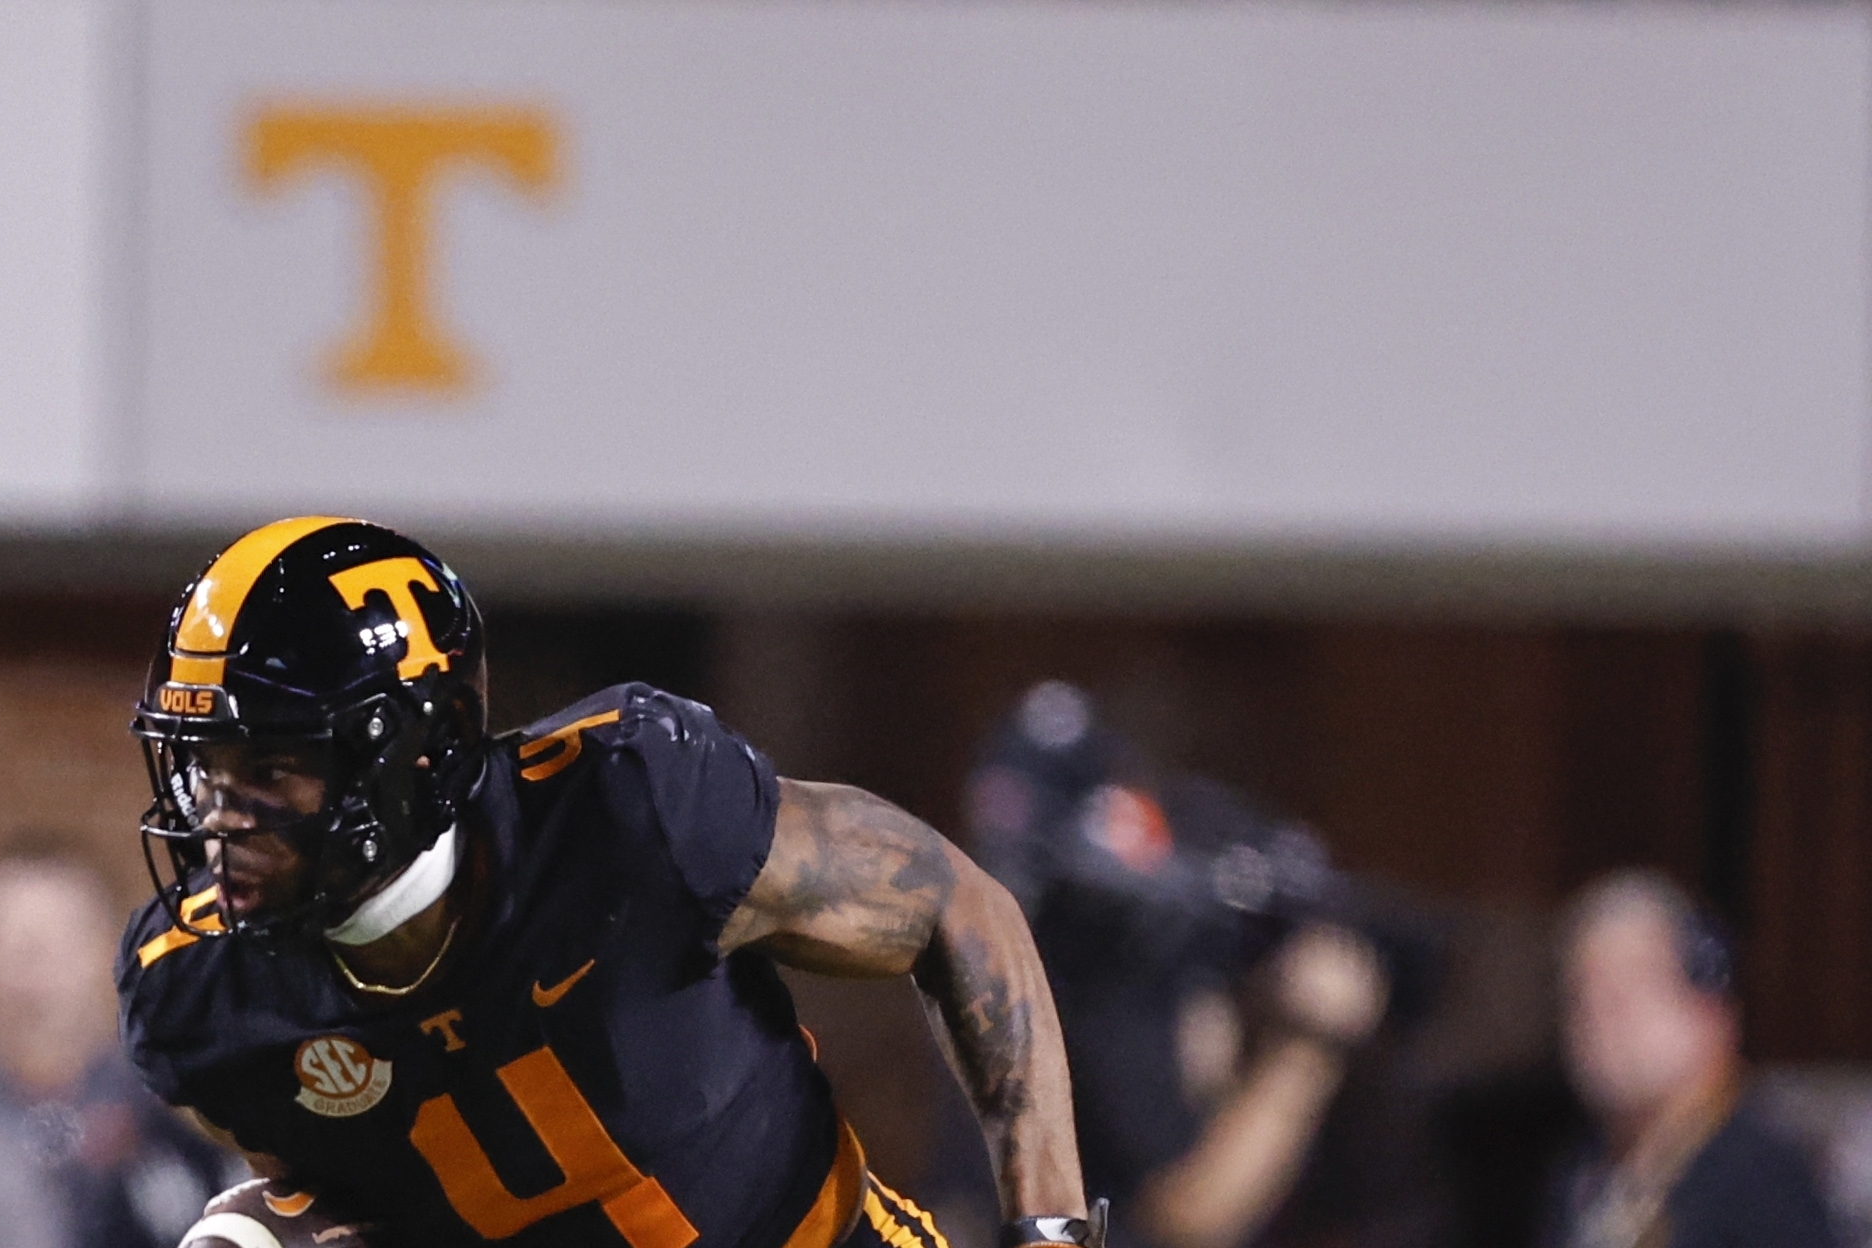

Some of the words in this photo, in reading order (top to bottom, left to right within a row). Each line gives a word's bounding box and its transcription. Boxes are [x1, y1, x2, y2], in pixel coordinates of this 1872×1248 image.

[240, 102, 562, 394] T
[328, 556, 450, 681] T
[160, 688, 214, 714] VOLS
[419, 1009, 466, 1052] T
[300, 1039, 367, 1094] SEC
